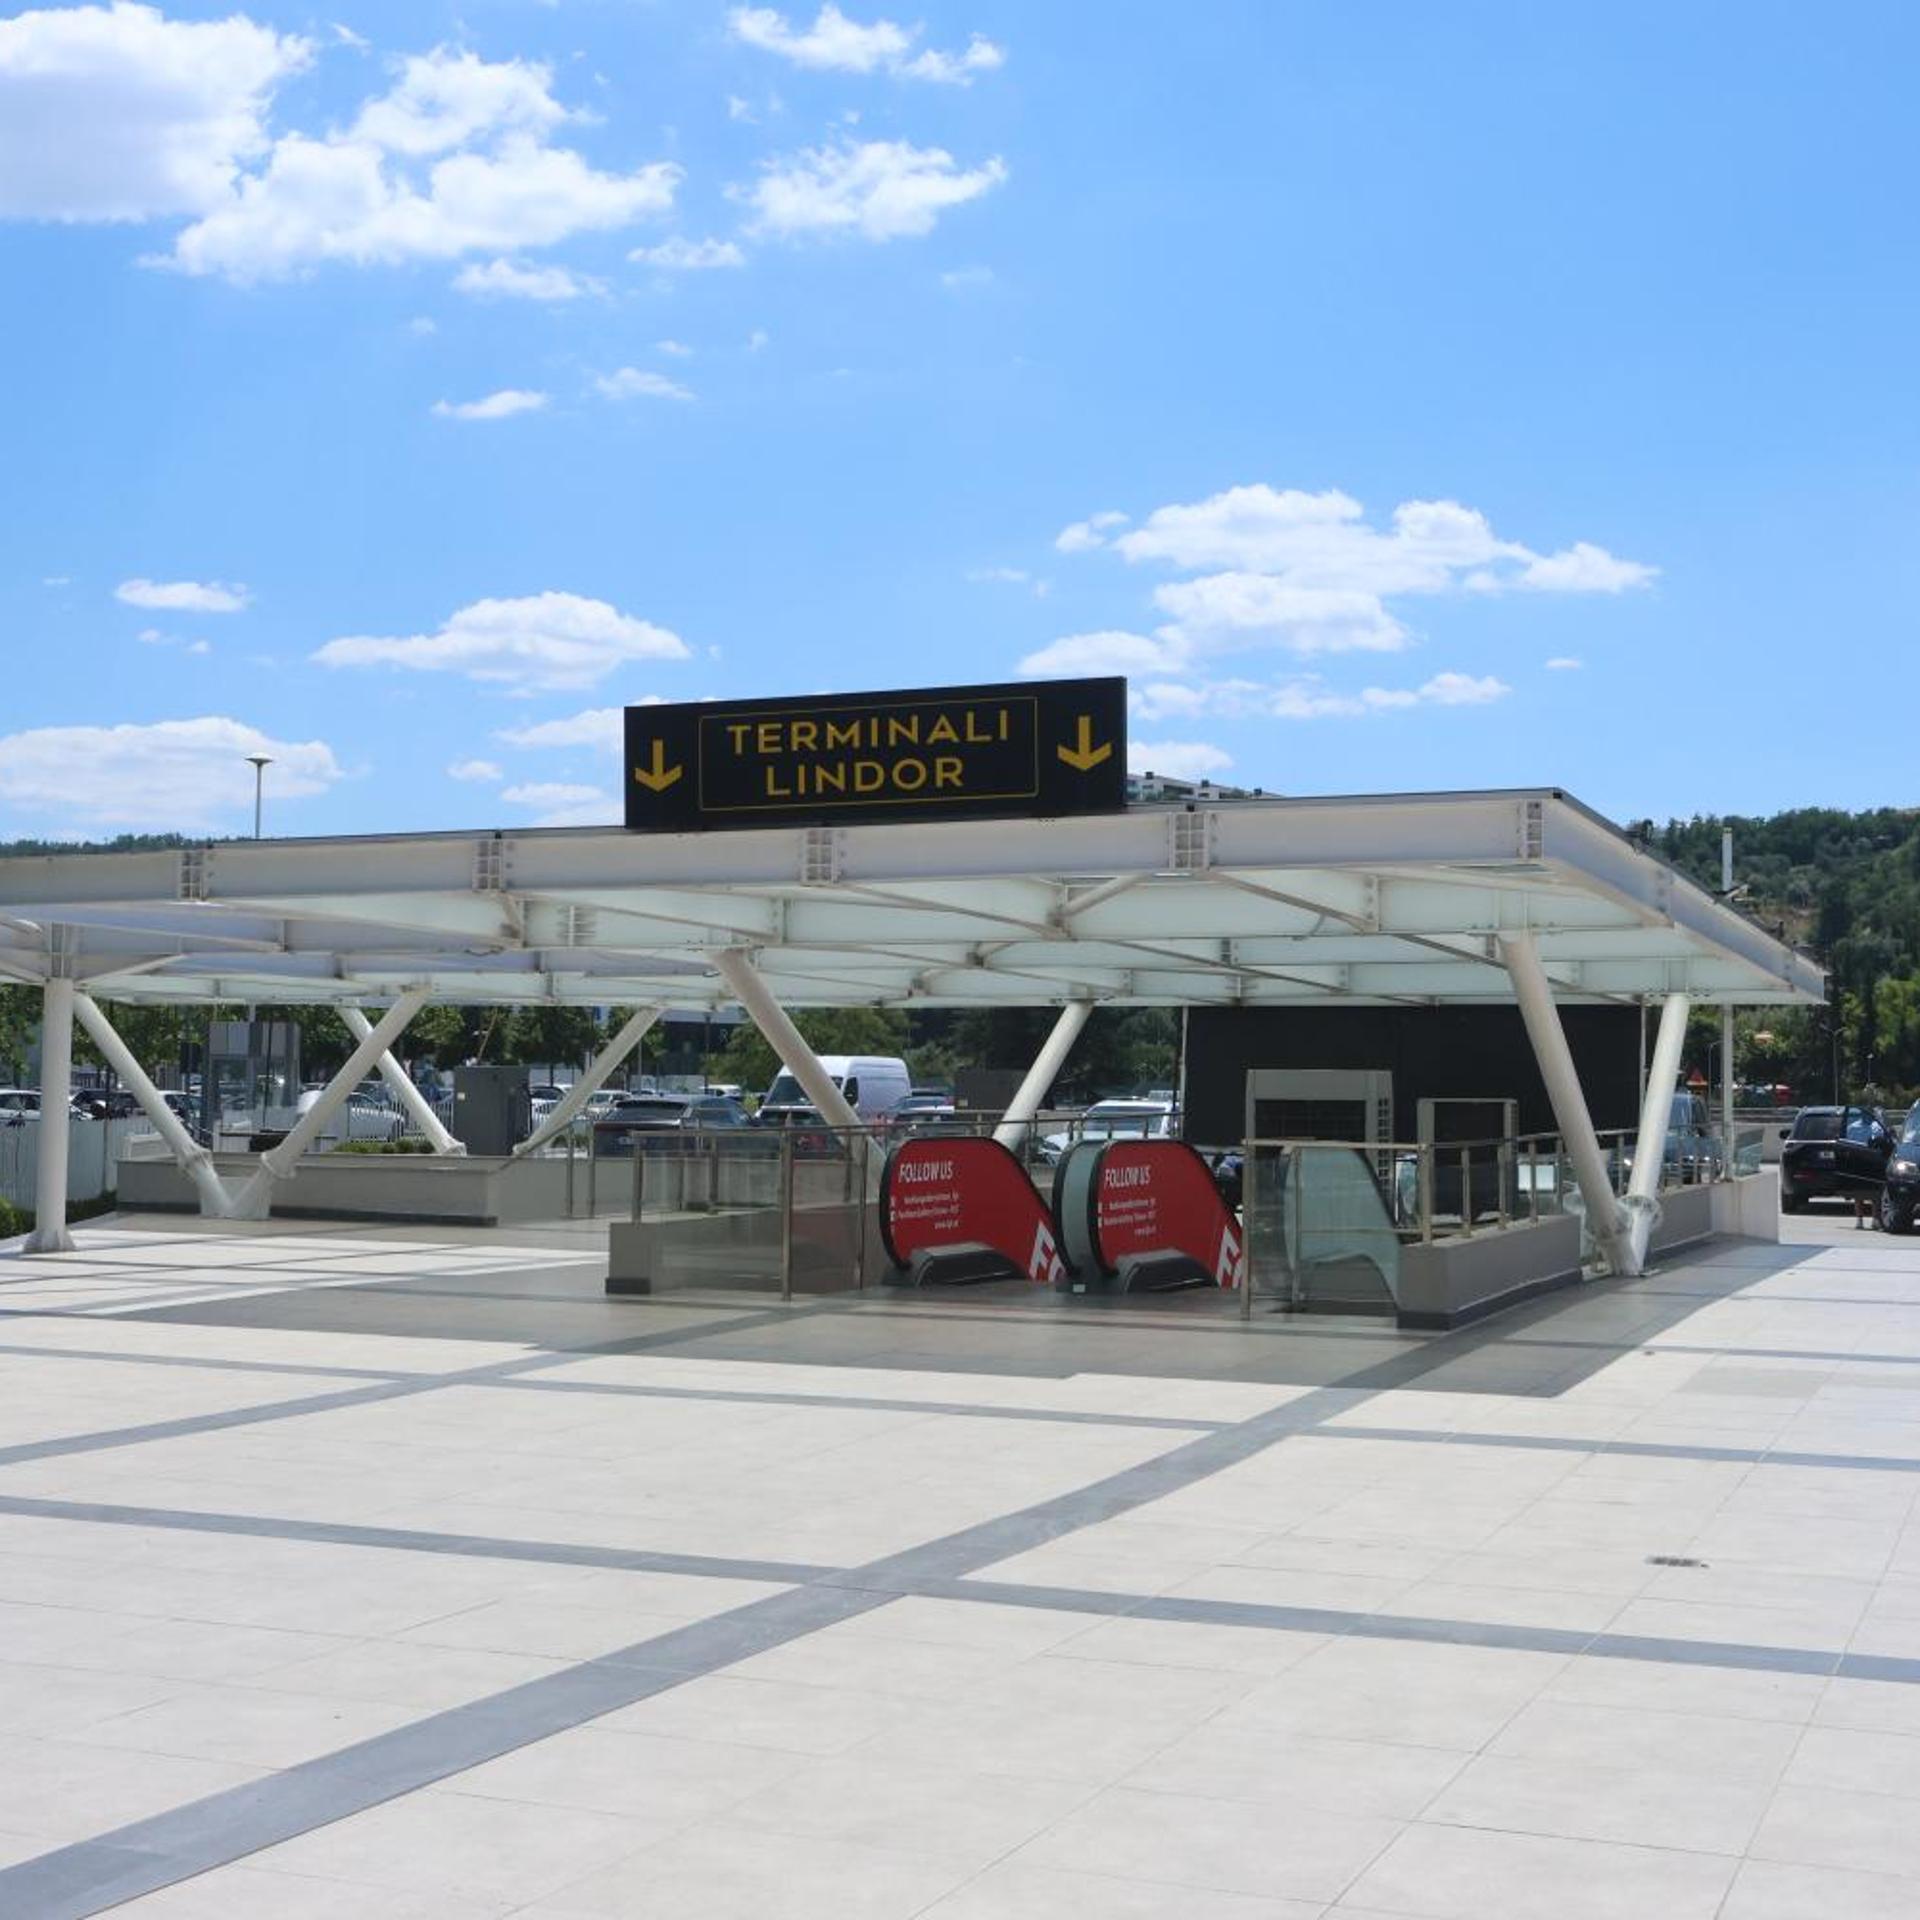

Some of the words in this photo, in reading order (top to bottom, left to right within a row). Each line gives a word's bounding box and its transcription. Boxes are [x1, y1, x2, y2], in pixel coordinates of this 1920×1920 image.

[727, 709, 1008, 755] TERMINALI
[765, 757, 965, 797] LINDOR
[898, 1161, 939, 1183] FOLLOW
[940, 1160, 953, 1180] US
[1104, 1167, 1139, 1188] FOLLOW
[1139, 1165, 1151, 1186] US
